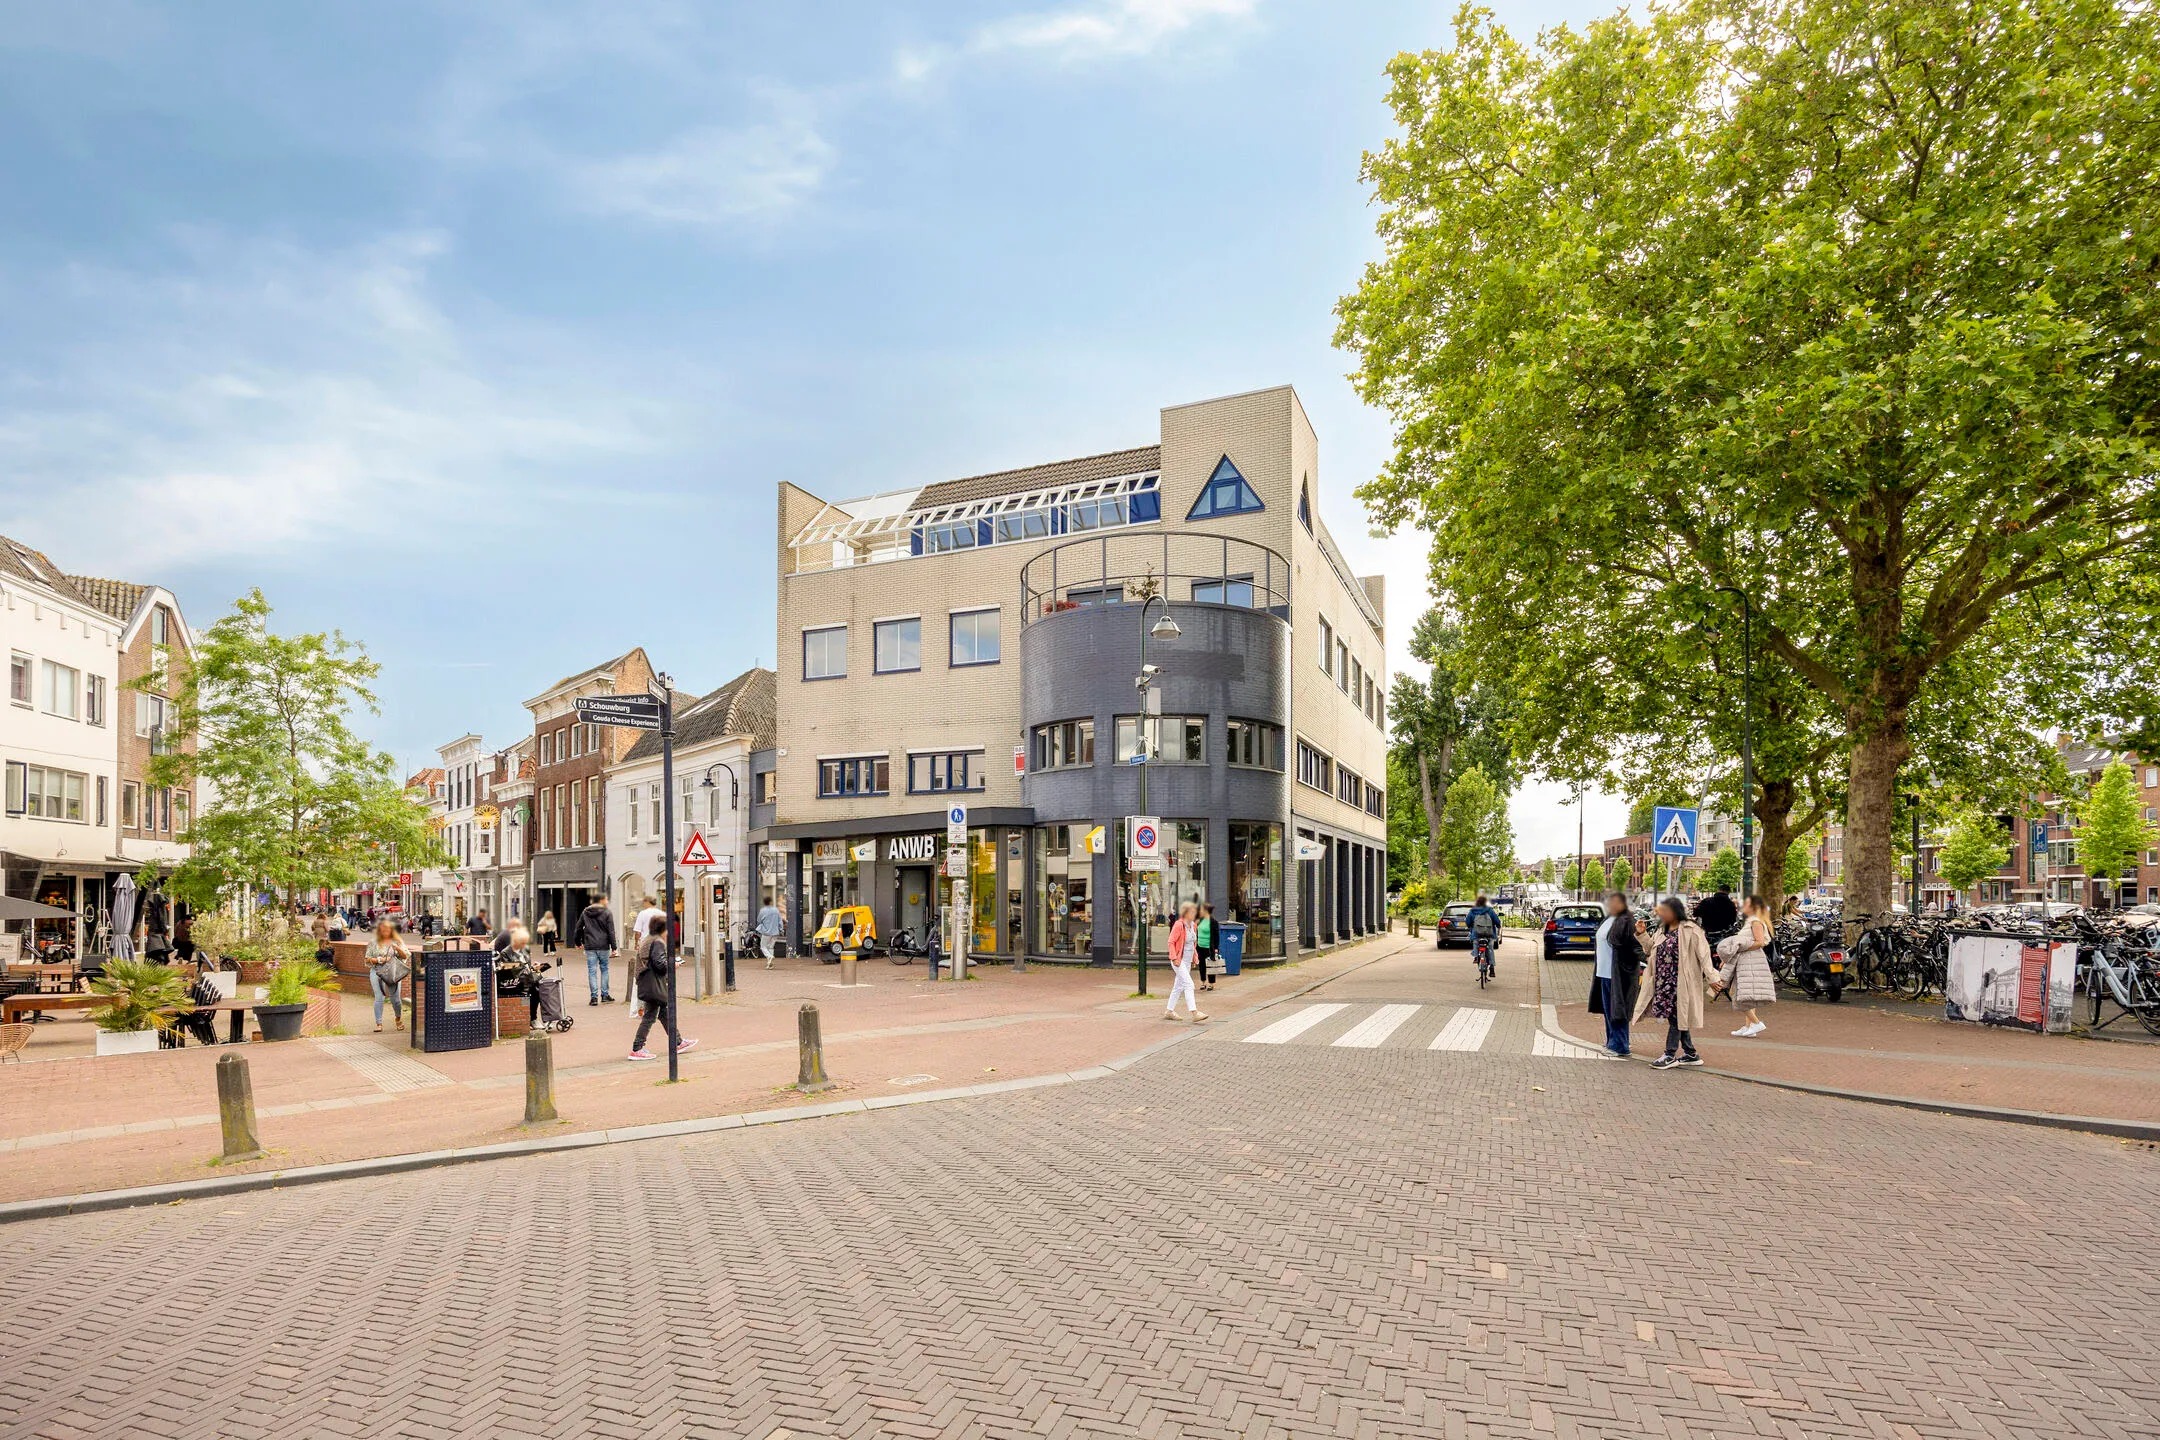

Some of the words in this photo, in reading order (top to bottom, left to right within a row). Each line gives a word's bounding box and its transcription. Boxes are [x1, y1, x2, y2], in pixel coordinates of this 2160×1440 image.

[589, 701, 631, 714] Schouwburg
[592, 714, 611, 722] Gouda
[611, 716, 631, 725] Cheese
[630, 718, 659, 728] Experience
[2036, 825, 2044, 840] P
[887, 835, 935, 860] ANWB
